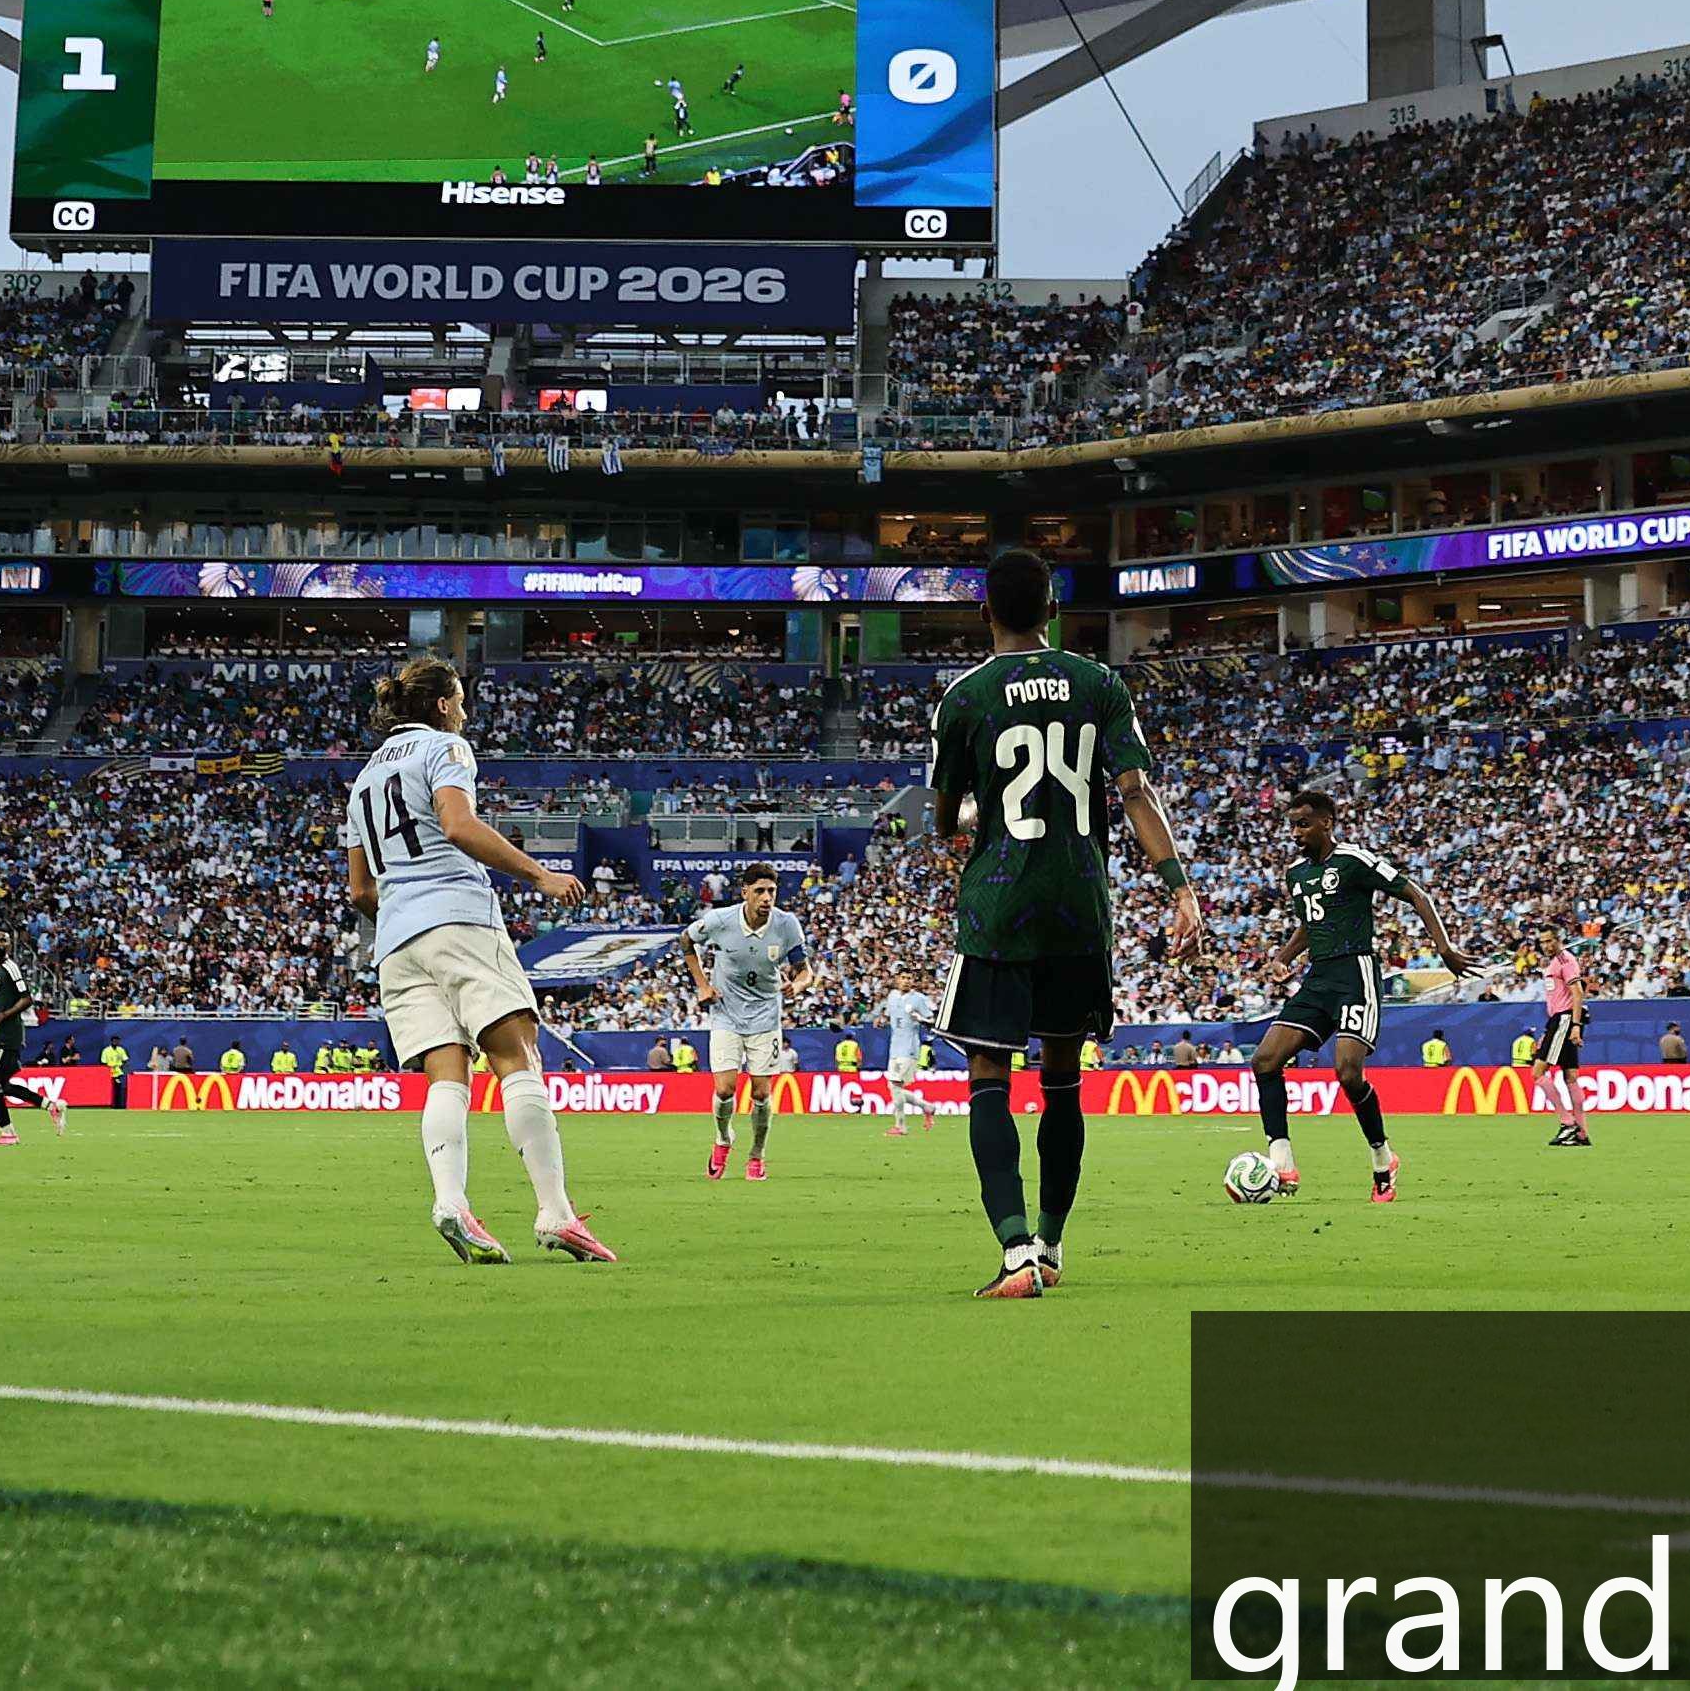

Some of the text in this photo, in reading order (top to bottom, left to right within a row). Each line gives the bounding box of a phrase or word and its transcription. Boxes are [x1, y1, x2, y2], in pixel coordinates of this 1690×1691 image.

[62, 37, 117, 91] 1
[888, 49, 957, 104] 0
[1389, 104, 1417, 126] 313
[441, 181, 566, 205] Hisense
[59, 206, 90, 227] CC
[910, 214, 942, 234] CC
[219, 262, 787, 304] FIFA WORLD CUP 2026
[977, 281, 1013, 301] 312
[1487, 531, 1544, 560] FIFA
[1543, 519, 1639, 558] WORLD
[522, 572, 643, 596] #FIFAWorldCup
[1118, 564, 1196, 595] MIAMI
[1005, 677, 1070, 707] MOTEB
[995, 721, 1097, 841] 24
[358, 772, 425, 876] 14
[652, 860, 683, 872] FIFA
[1303, 891, 1326, 923] 15
[746, 970, 758, 988] 8
[1339, 1004, 1364, 1031] 15
[772, 1037, 780, 1060] 8
[236, 1075, 403, 1111] McDonald's
